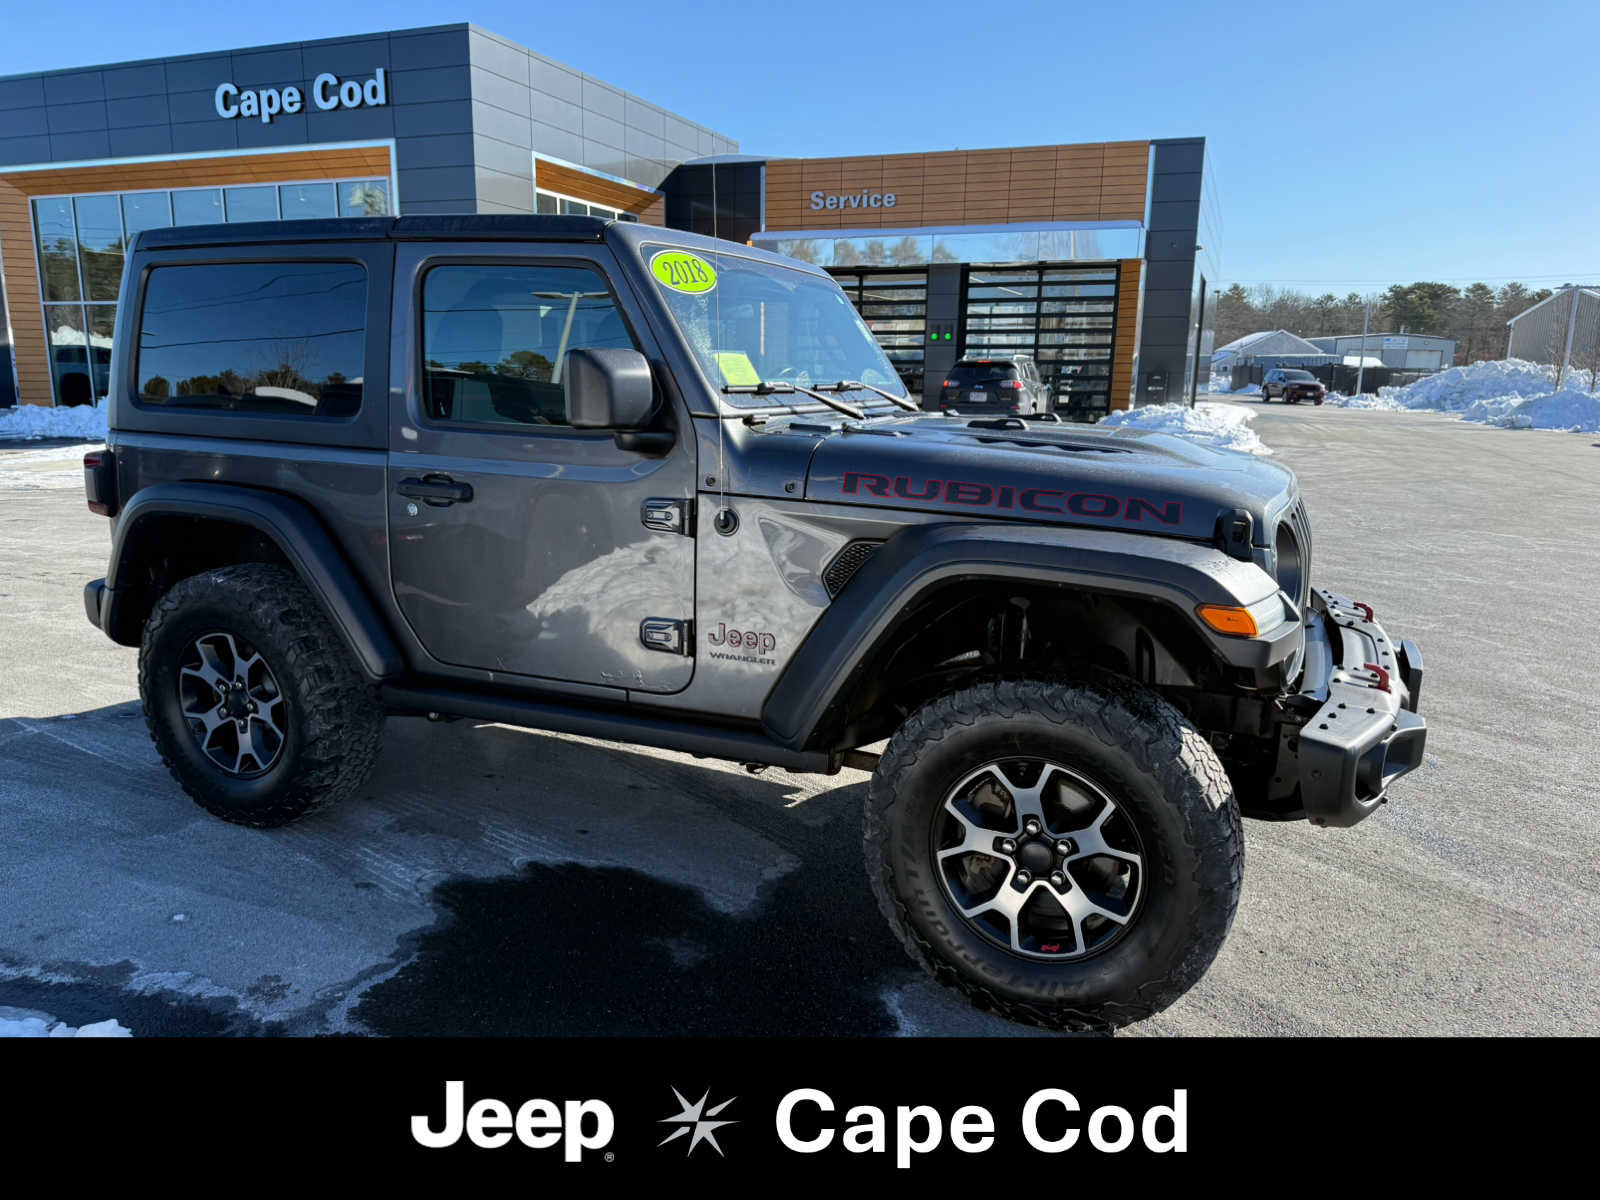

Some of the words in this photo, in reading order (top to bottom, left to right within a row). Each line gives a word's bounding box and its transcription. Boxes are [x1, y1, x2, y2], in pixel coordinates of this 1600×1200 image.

[215, 83, 302, 124] Cape
[313, 68, 387, 111] Cod
[810, 189, 897, 211] Service
[662, 258, 709, 286] 2018
[841, 471, 1184, 526] RUBICON
[707, 622, 776, 655] Jeep
[709, 651, 777, 666] WRANGLER
